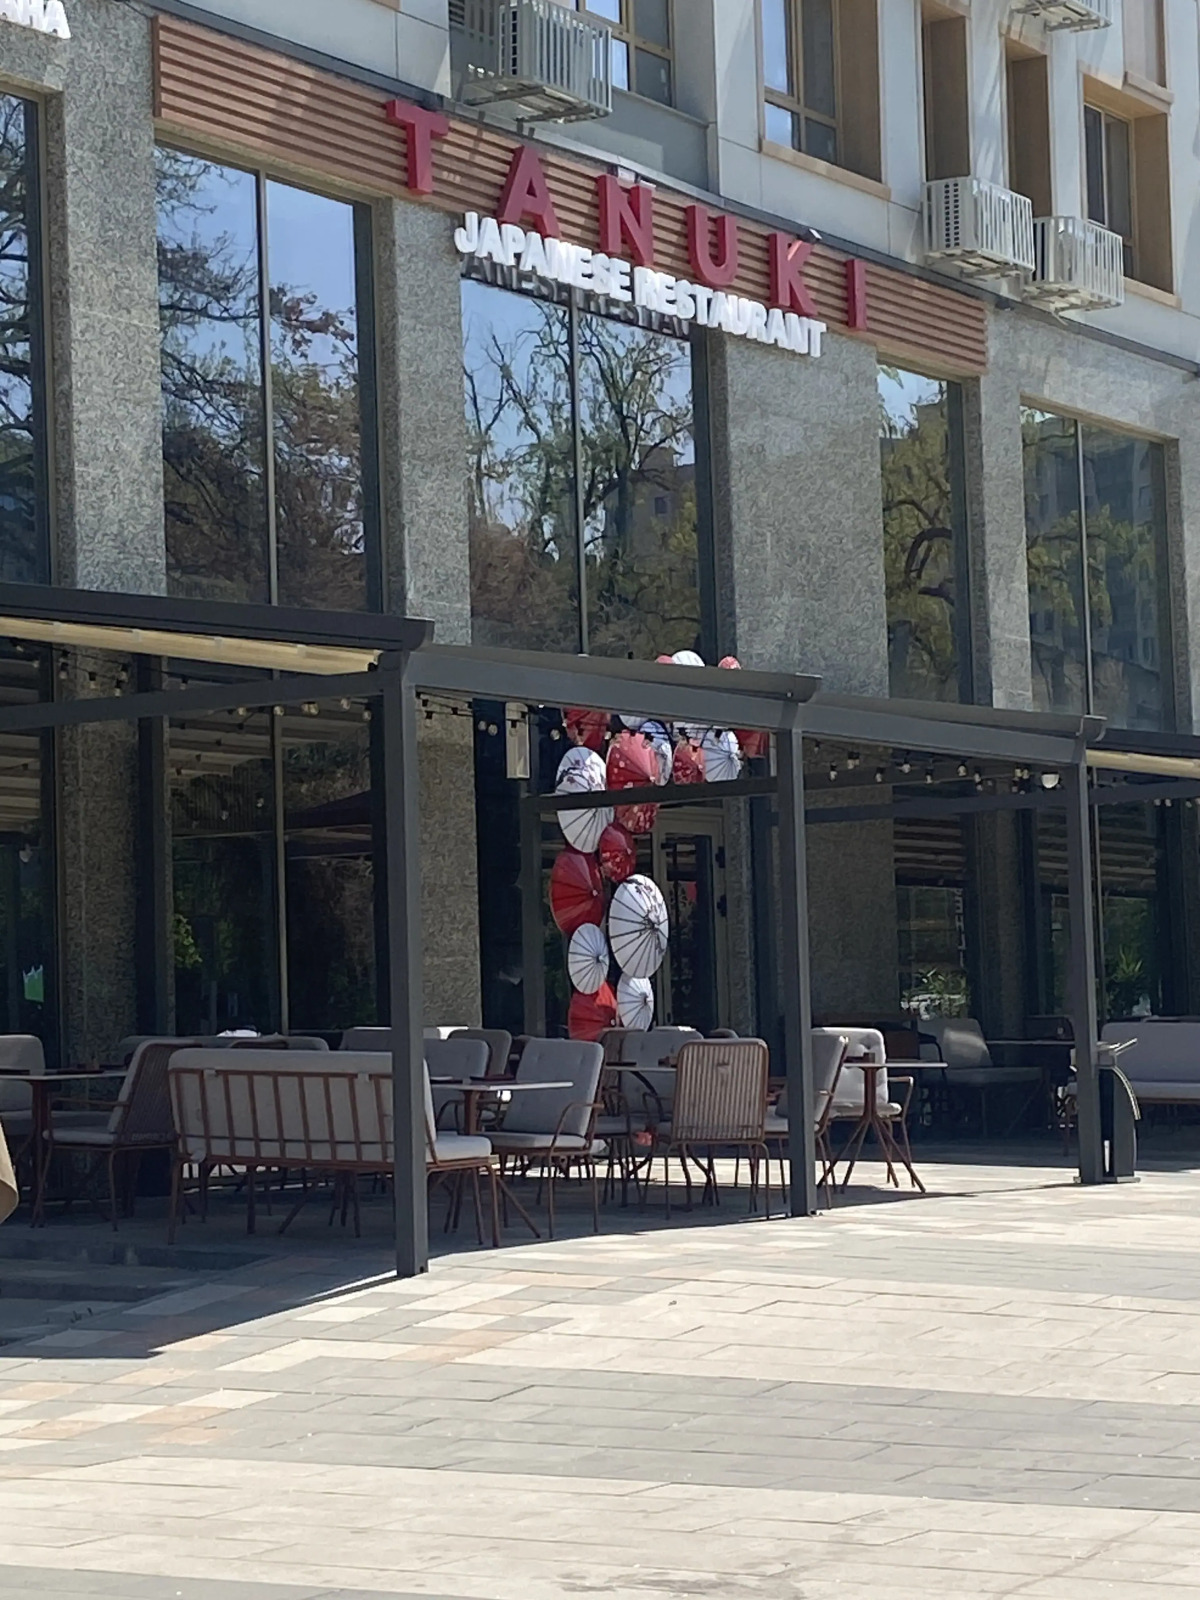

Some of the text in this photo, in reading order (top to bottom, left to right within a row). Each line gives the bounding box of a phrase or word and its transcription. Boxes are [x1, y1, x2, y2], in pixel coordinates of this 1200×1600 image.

[385, 99, 868, 331] TANUKI
[454, 211, 827, 358] JAPANESE RESTAURANT
